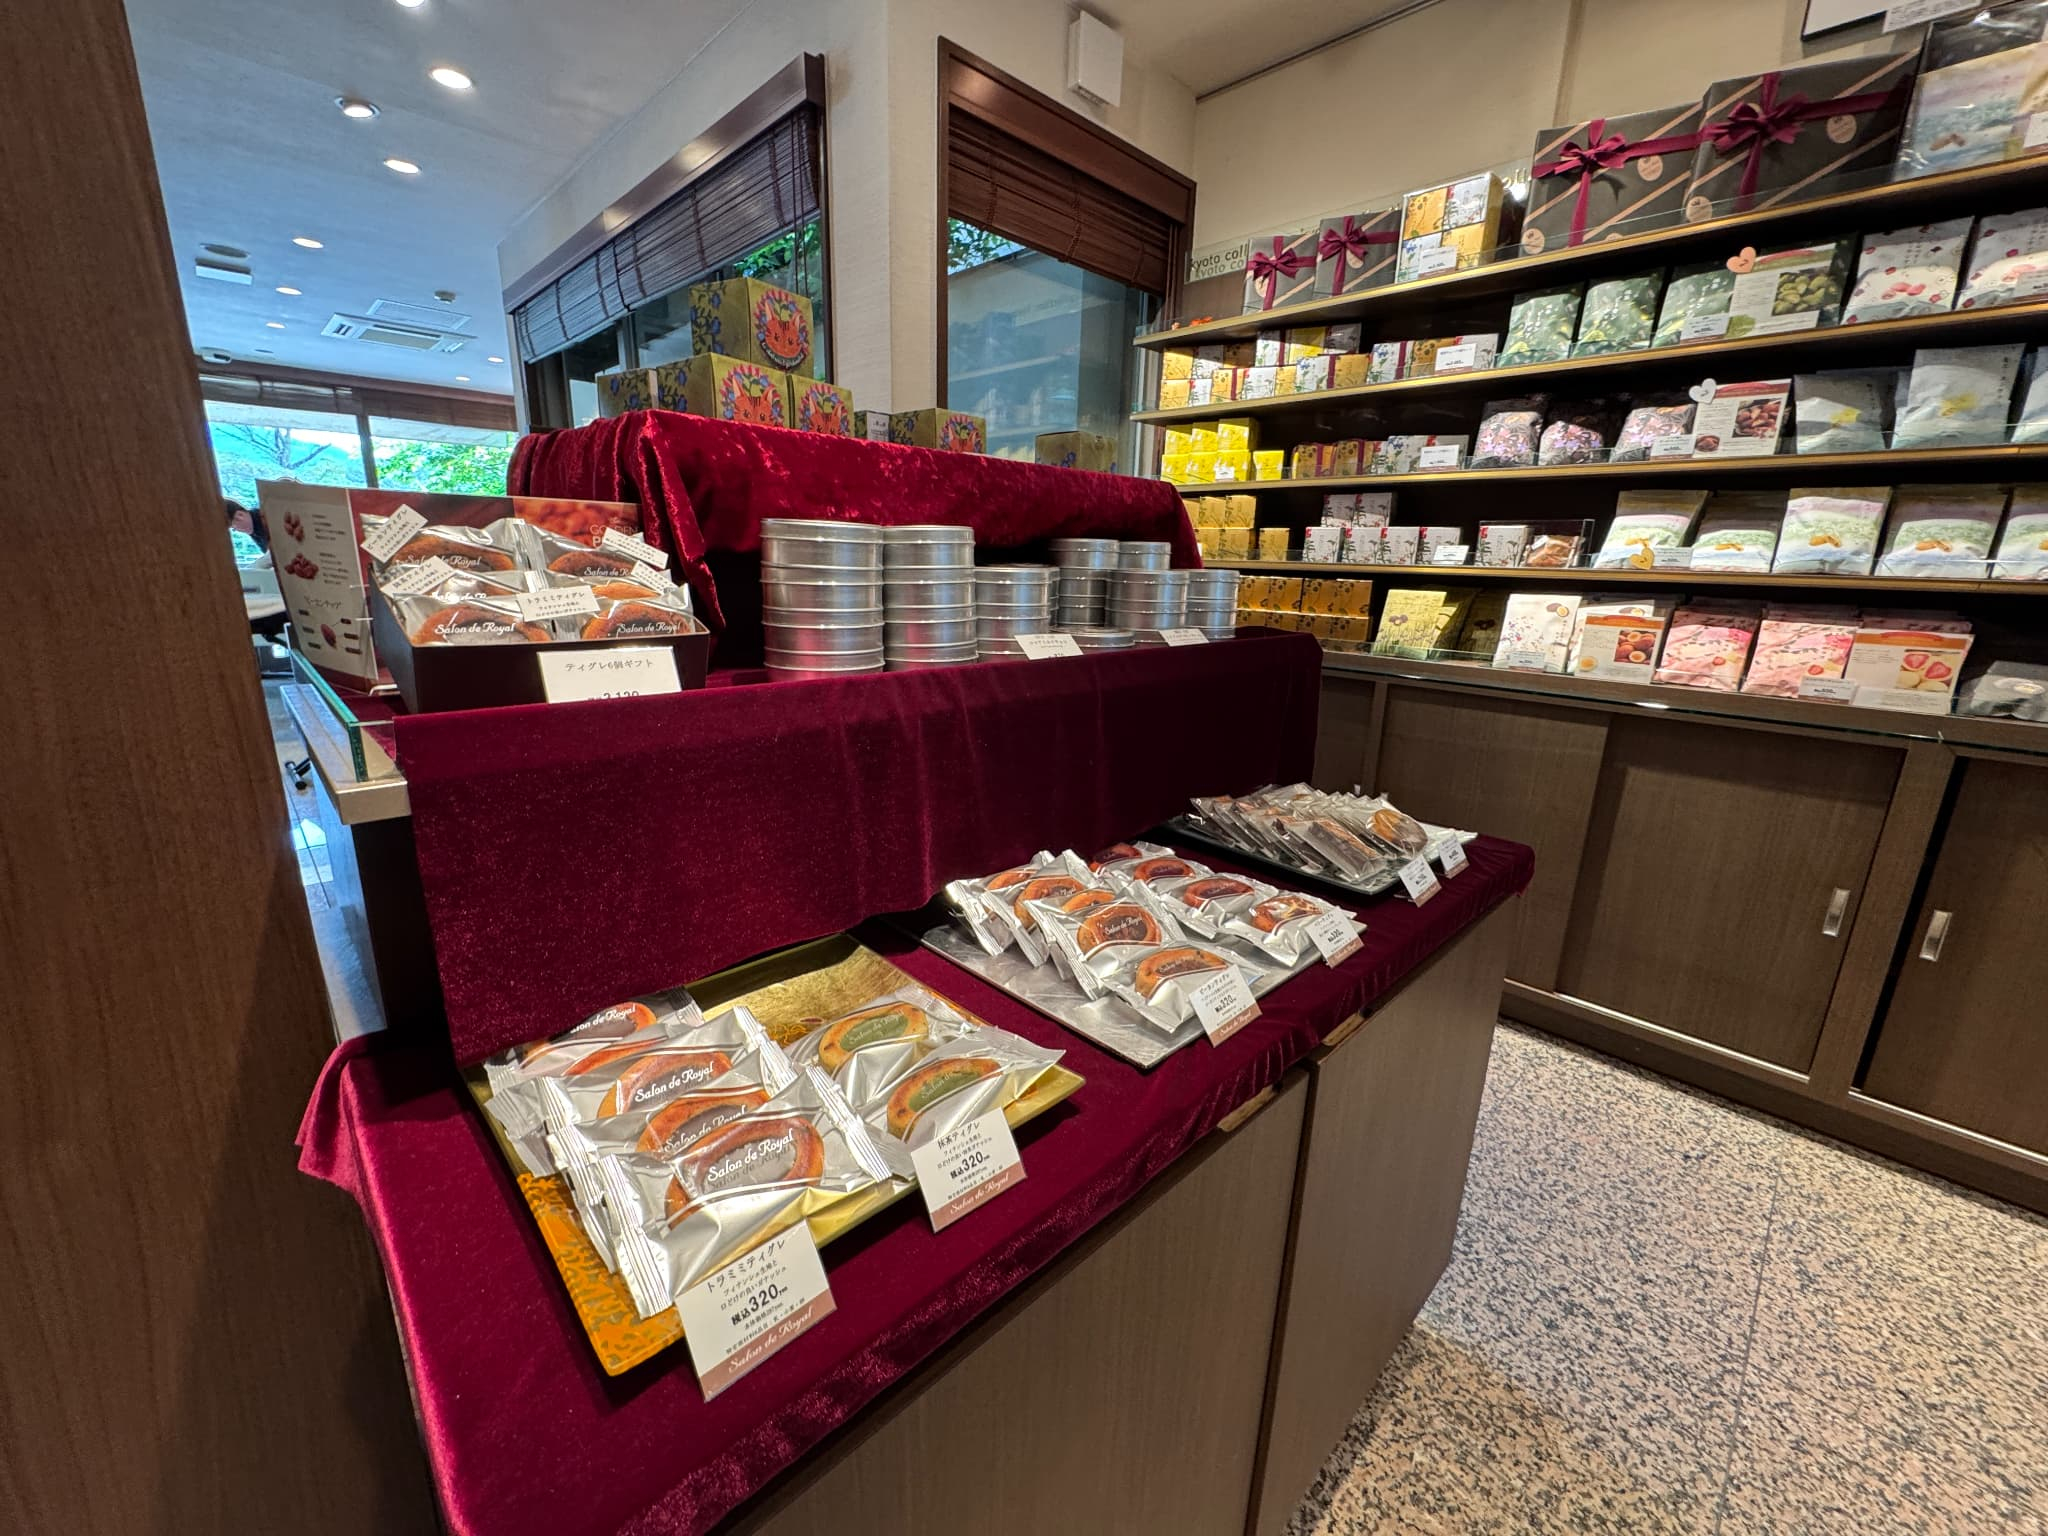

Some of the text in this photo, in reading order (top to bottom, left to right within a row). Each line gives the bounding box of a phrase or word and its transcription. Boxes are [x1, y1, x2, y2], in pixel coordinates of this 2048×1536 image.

[448, 555, 481, 569] Royal
[583, 566, 609, 577] Salon
[609, 567, 620, 576] de
[434, 621, 516, 636] Salon de Royal
[617, 621, 681, 635] Salon de Royal
[592, 1012, 606, 1026] de
[604, 1003, 637, 1022] Royal
[634, 1060, 715, 1103] Salon de Royal
[663, 1132, 698, 1154] Salon
[697, 1122, 712, 1137] de
[937, 1121, 981, 1150] 抹茶ティグレ
[707, 1127, 795, 1183] Salon de Royal
[728, 1305, 814, 1374] Salon de Royal
